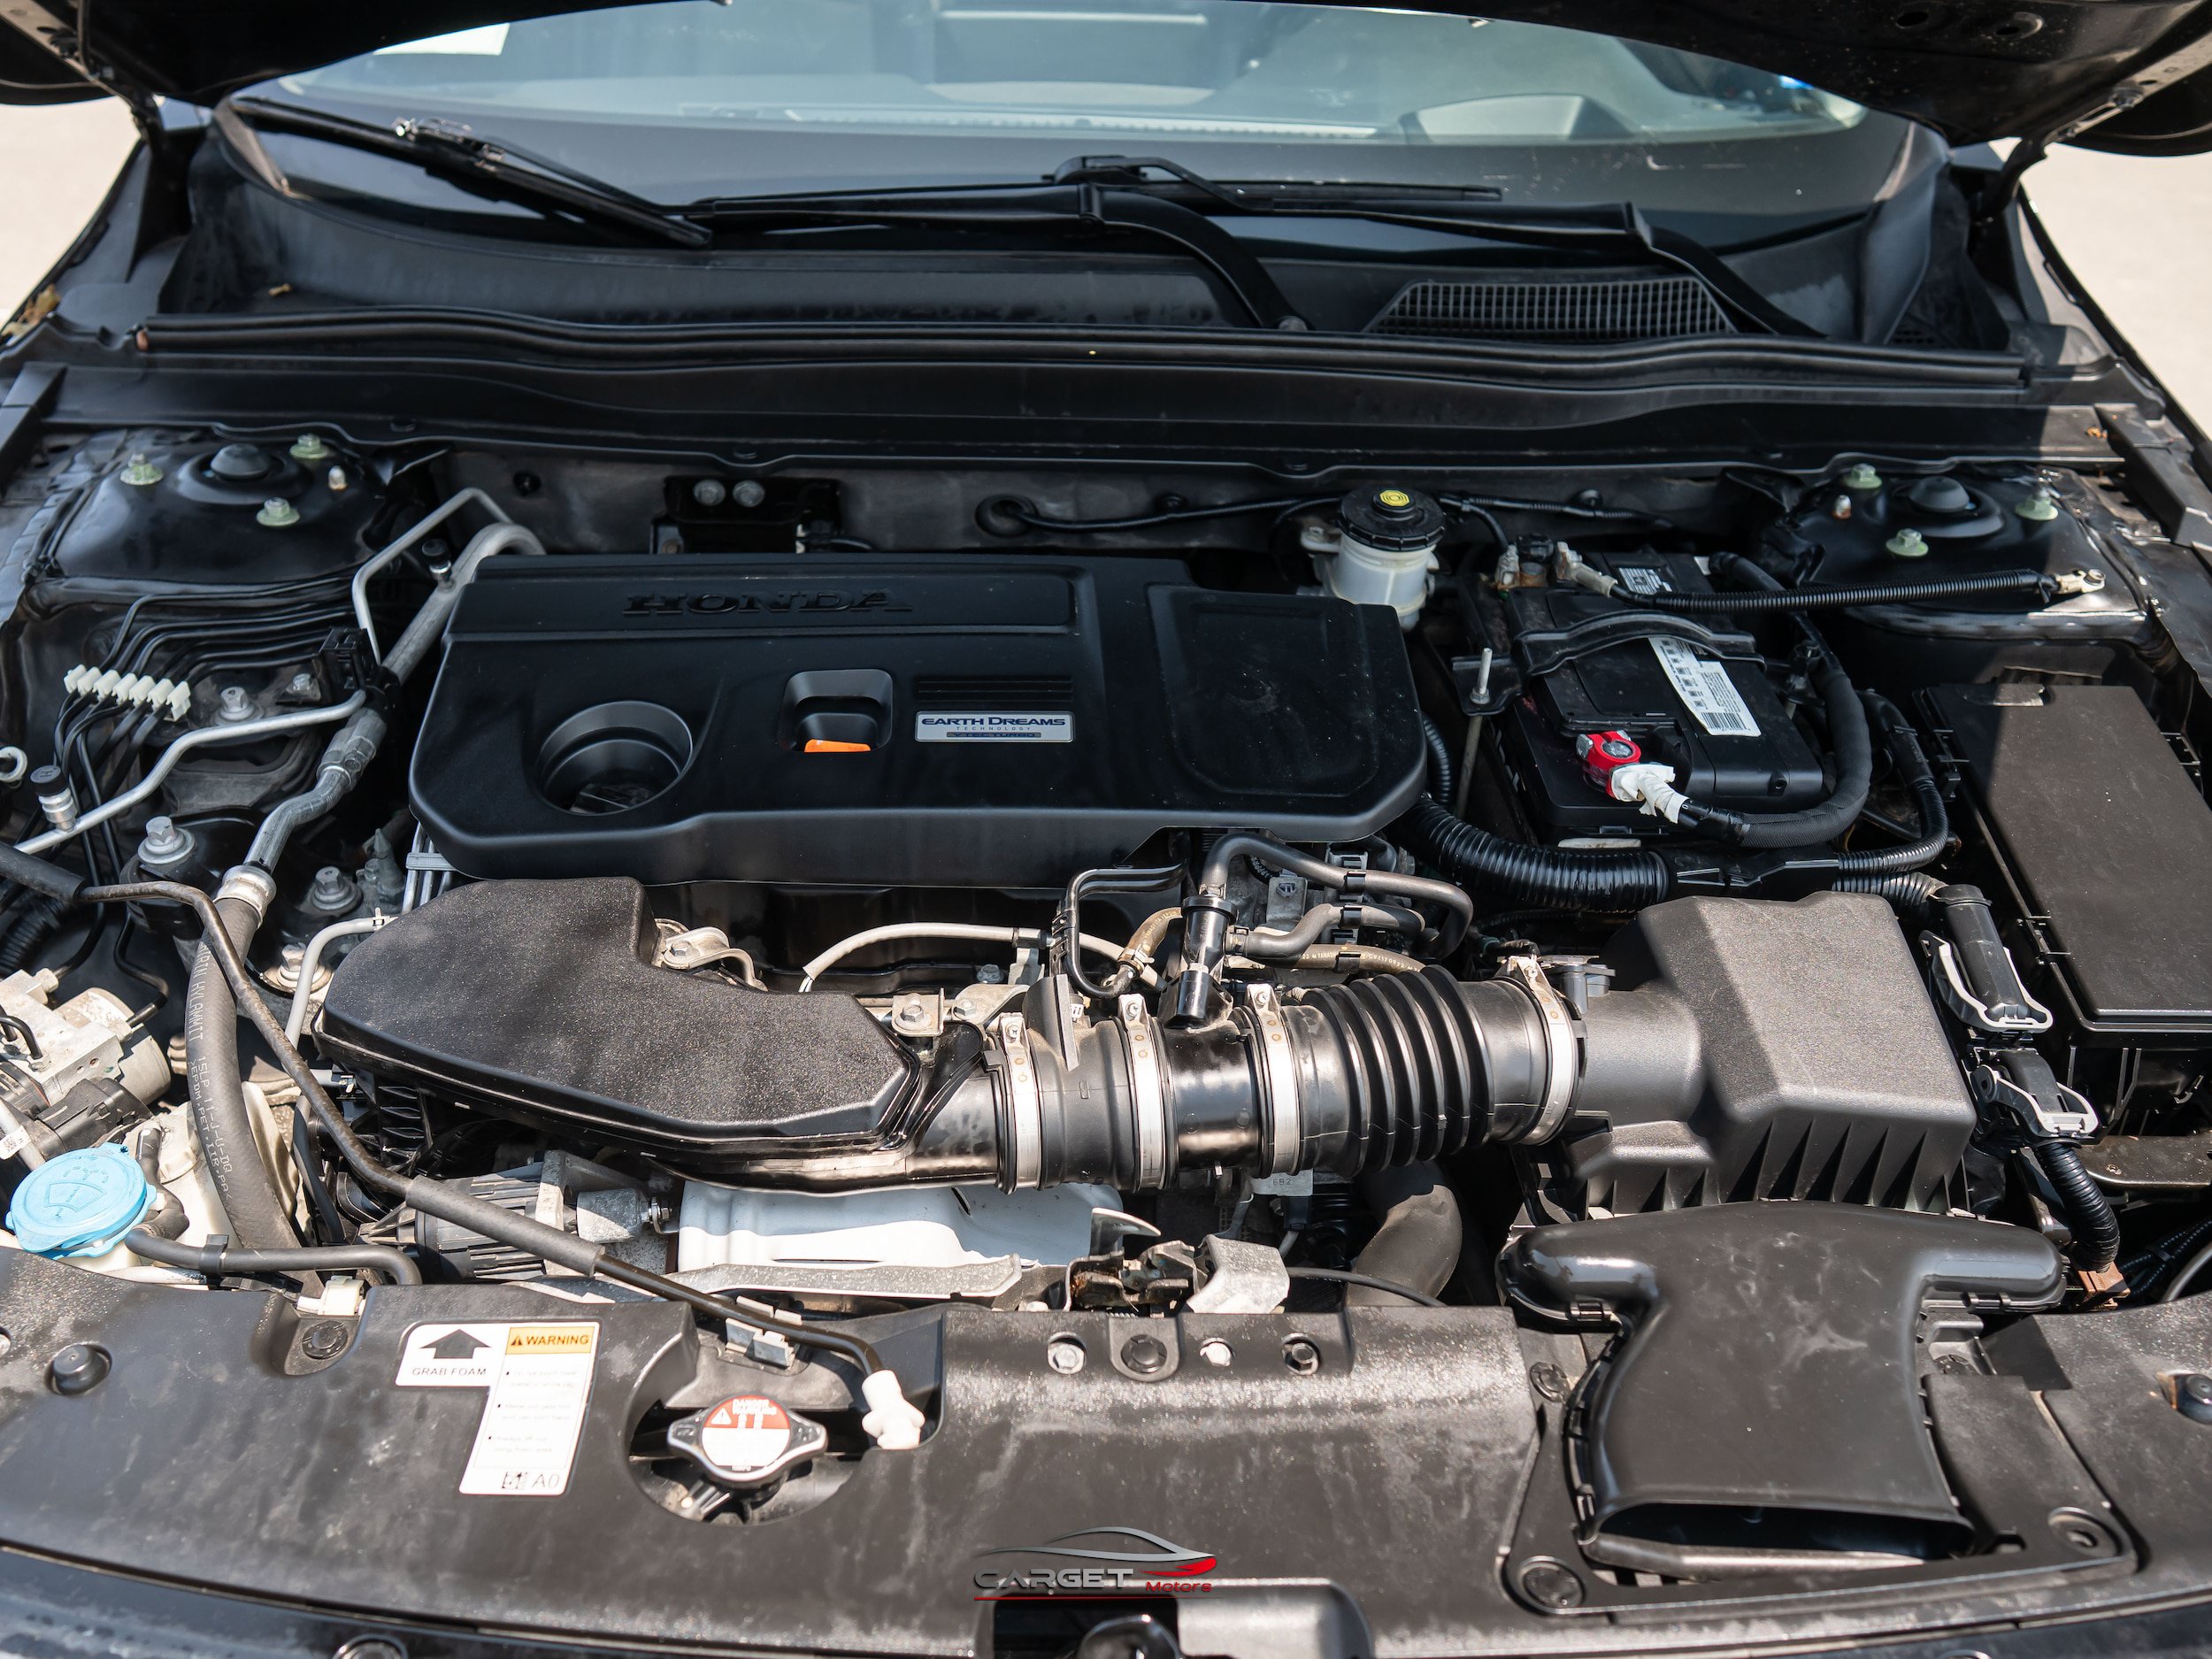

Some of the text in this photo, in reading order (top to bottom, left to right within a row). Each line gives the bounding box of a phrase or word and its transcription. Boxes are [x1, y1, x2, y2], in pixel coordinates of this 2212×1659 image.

[623, 589, 912, 615] HONDA
[988, 717, 1065, 726] DREAMS
[526, 1334, 589, 1346] WARNING
[412, 1367, 487, 1376] GRAB FOAM
